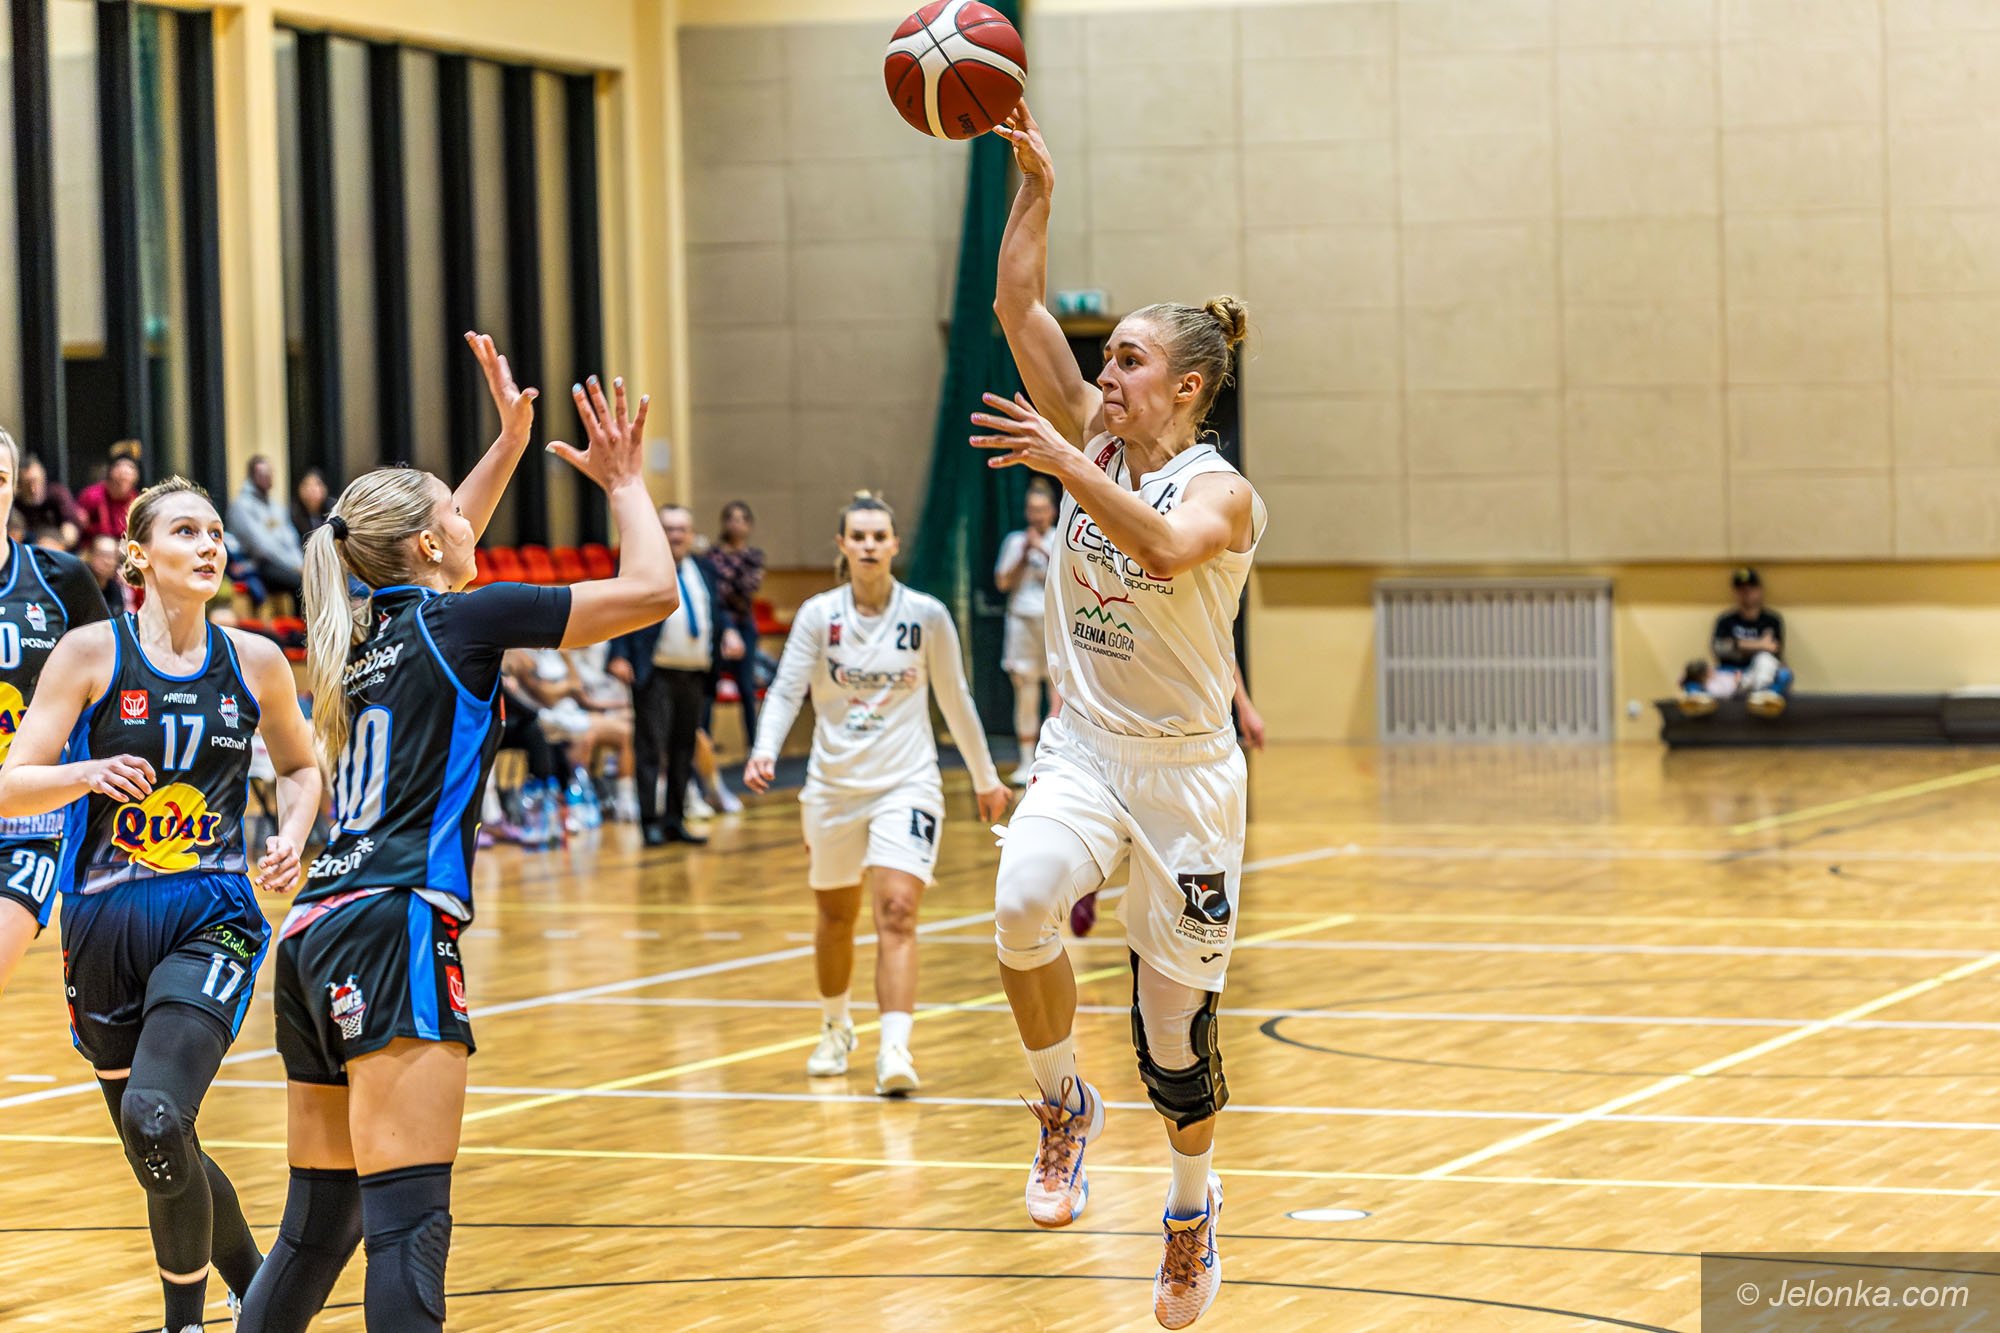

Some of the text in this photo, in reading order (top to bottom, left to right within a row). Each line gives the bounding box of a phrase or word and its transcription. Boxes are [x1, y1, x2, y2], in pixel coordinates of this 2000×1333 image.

[1123, 578, 1174, 595] sportu
[896, 623, 921, 650] 20
[1072, 621, 1135, 653] JELENIA GÓRA
[167, 692, 198, 705] PROTON
[160, 713, 205, 771] 17
[113, 801, 219, 852] QUAY
[7, 848, 56, 904] 20
[201, 952, 246, 1004] 17
